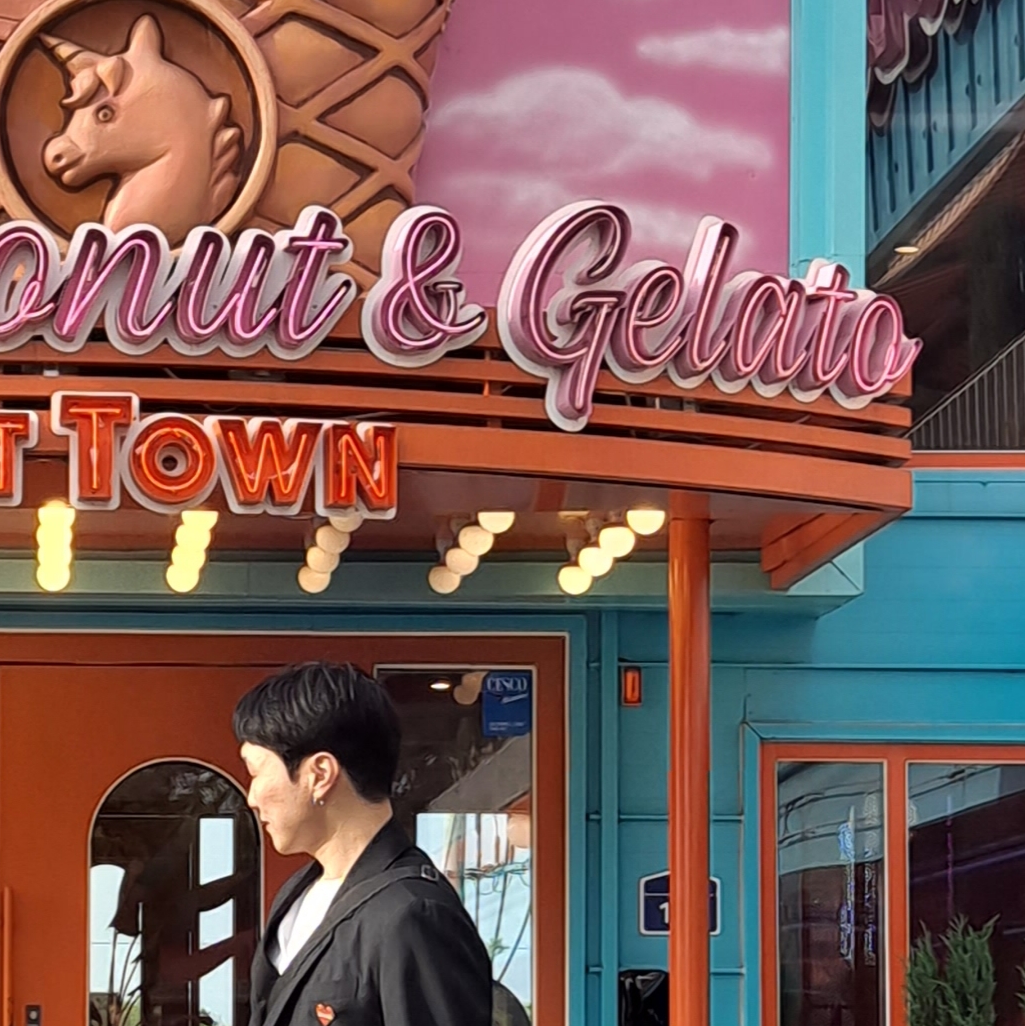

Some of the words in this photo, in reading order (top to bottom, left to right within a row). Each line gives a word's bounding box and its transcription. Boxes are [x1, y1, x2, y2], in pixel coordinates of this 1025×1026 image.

[361, 205, 488, 368] &
[497, 199, 924, 431] Gelato
[50, 391, 399, 519] TOWN
